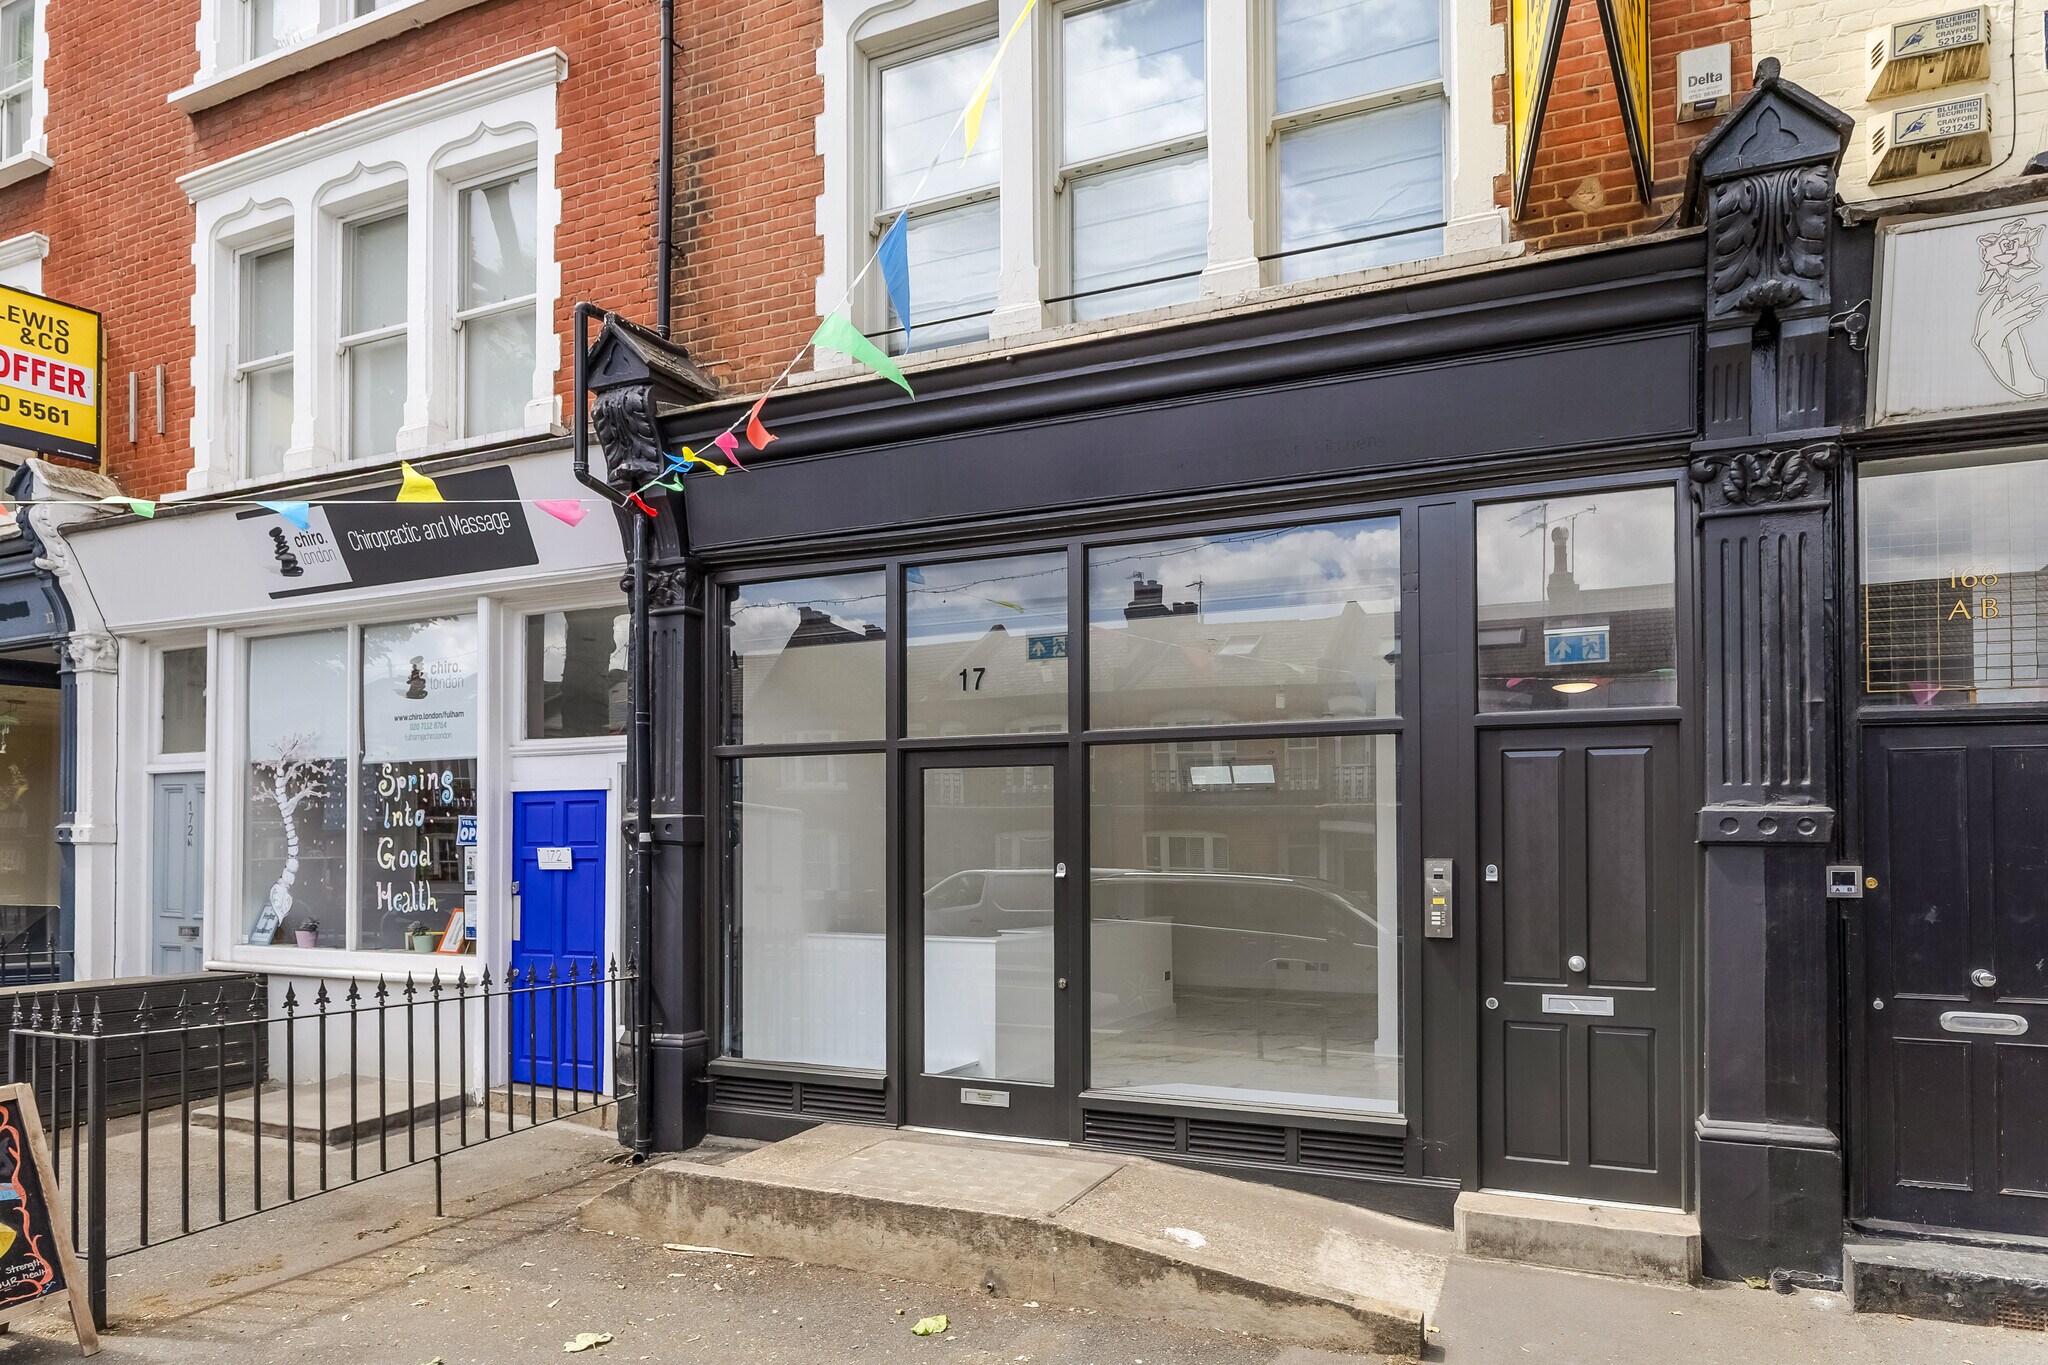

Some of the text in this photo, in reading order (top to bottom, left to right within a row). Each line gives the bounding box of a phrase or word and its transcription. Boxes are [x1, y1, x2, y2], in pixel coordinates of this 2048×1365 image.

[1936, 12, 1977, 25] BLUEBIRD
[1936, 18, 1977, 30] SECURITIES
[1936, 25, 1976, 38] CRAYFORD
[1938, 33, 1973, 46] 521245
[1688, 72, 1722, 87] Delta
[1937, 101, 1978, 113] BLUEBIRD
[1937, 107, 1978, 118] SECURITIES
[1937, 114, 1978, 126] CRAYFORD
[1940, 122, 1975, 134] 521245
[20, 327, 69, 355] &CO
[19, 399, 69, 426] 5561
[294, 531, 328, 548] chiro.
[347, 511, 511, 551] Chiropractic and Massage
[299, 547, 338, 565] london
[1947, 565, 1998, 589] 168
[430, 661, 462, 675] chiro.
[430, 676, 464, 690] london
[959, 667, 986, 691] 17
[378, 762, 454, 804] Spring
[384, 801, 425, 829] Into
[377, 836, 432, 872] Good
[376, 880, 439, 914] Health
[5, 1258, 44, 1275] strength
